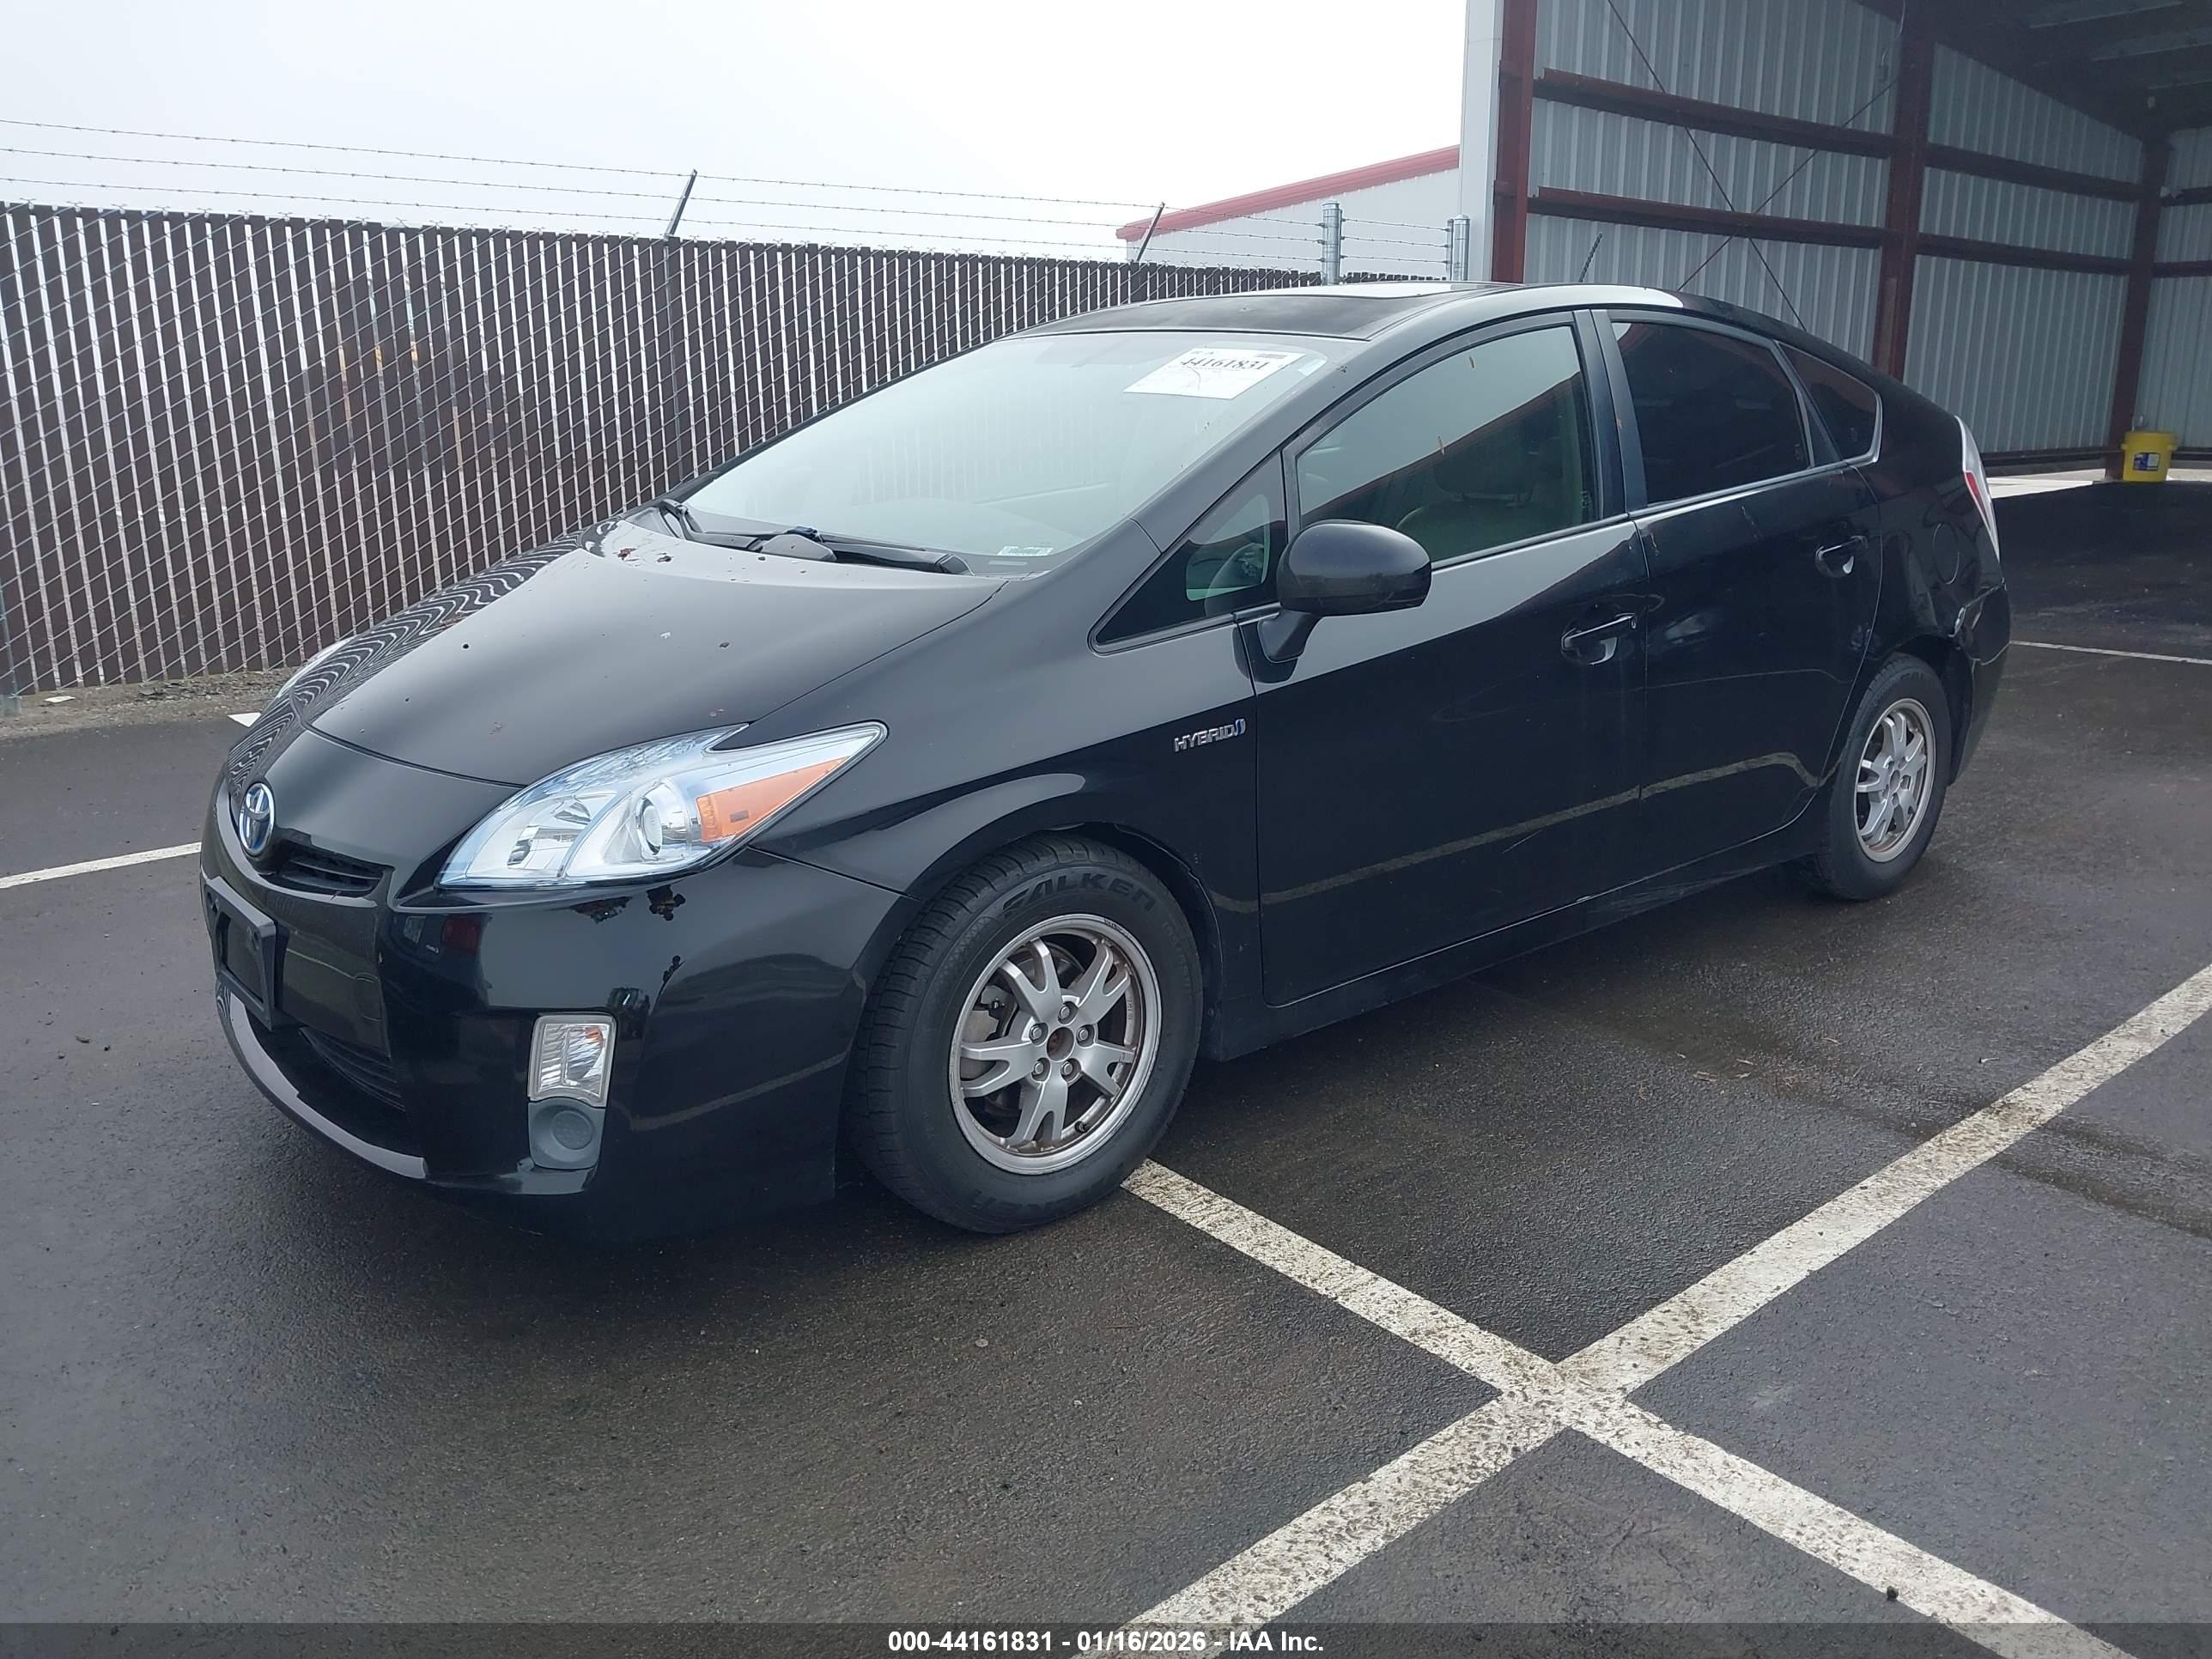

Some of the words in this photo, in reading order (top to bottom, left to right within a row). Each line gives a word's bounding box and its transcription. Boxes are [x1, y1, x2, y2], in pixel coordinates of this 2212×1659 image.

[1180, 357, 1270, 370] 44161831
[1174, 724, 1236, 752] HYBRID
[1002, 872, 1156, 919] FALKEN
